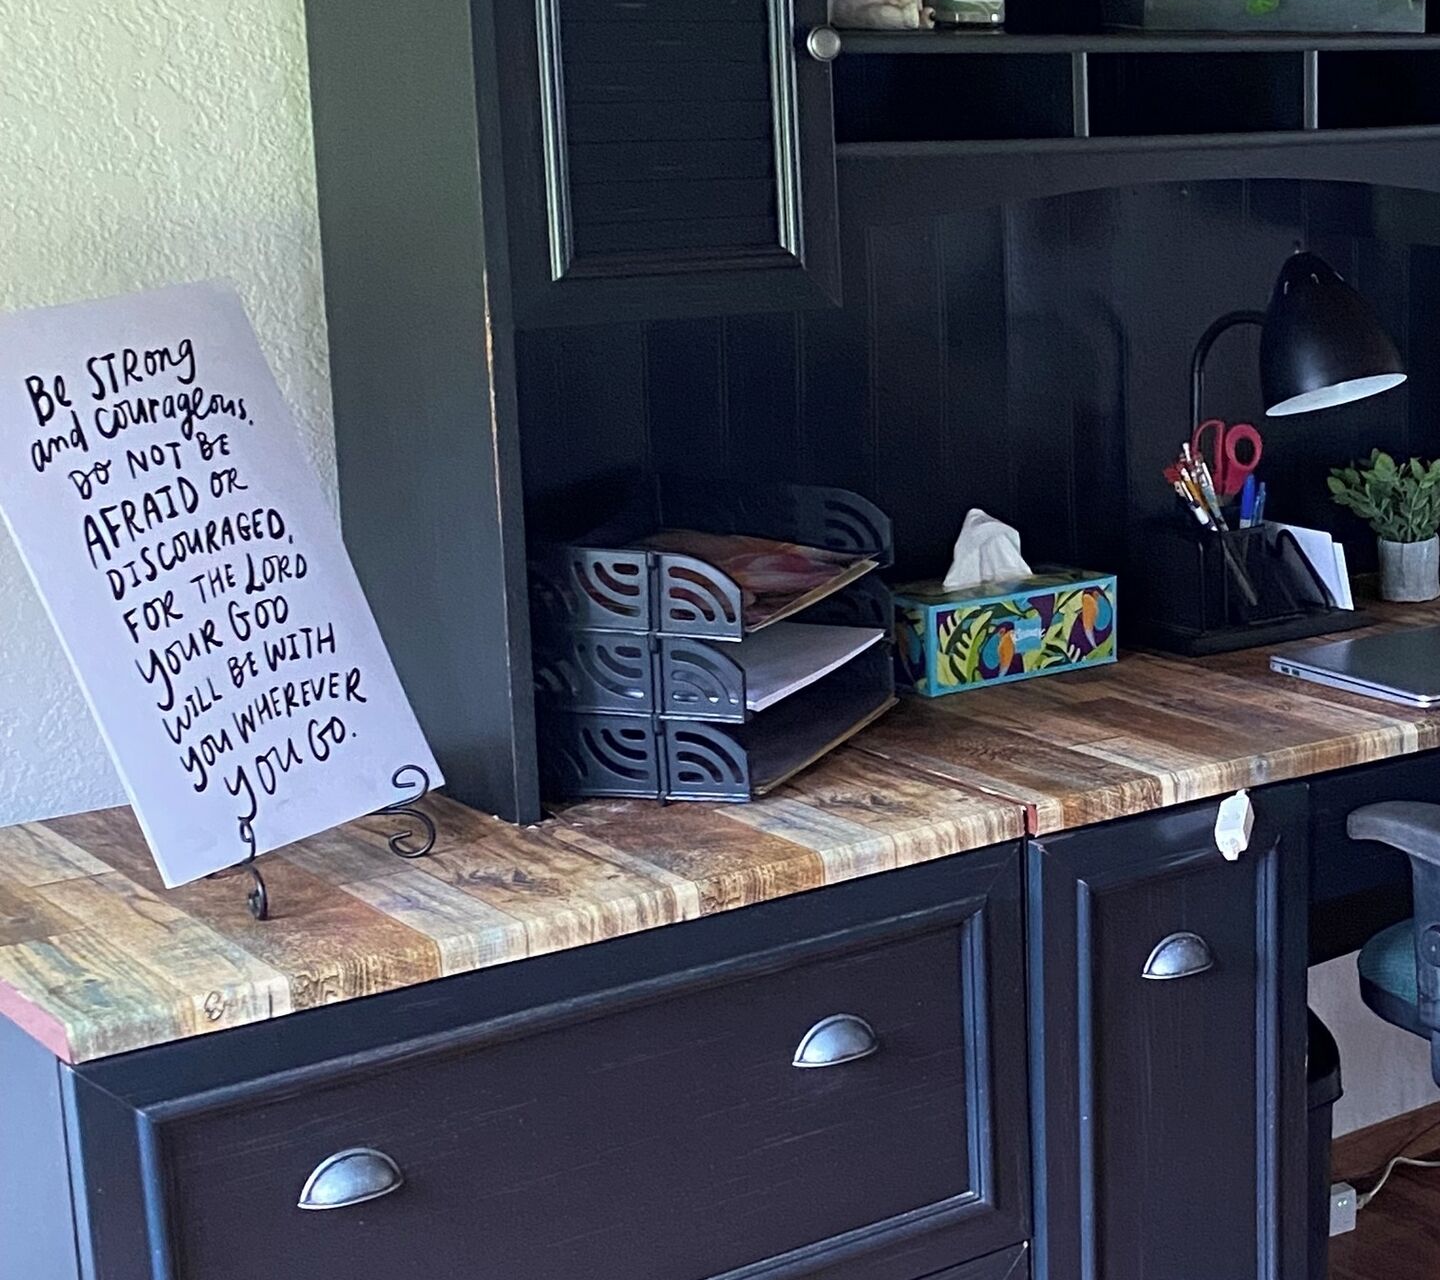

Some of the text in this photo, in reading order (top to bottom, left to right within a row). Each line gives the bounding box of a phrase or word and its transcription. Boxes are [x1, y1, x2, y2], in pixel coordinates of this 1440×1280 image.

[25, 375, 72, 426] Be
[31, 409, 89, 473] and
[68, 431, 231, 500] DO NOT BE
[84, 467, 249, 569] AFRAID OR
[122, 552, 308, 643] FOR THE LORD
[134, 595, 289, 711] YOUR GOD
[162, 622, 336, 745] WILL BE WITH
[232, 667, 367, 744] WHEREVER
